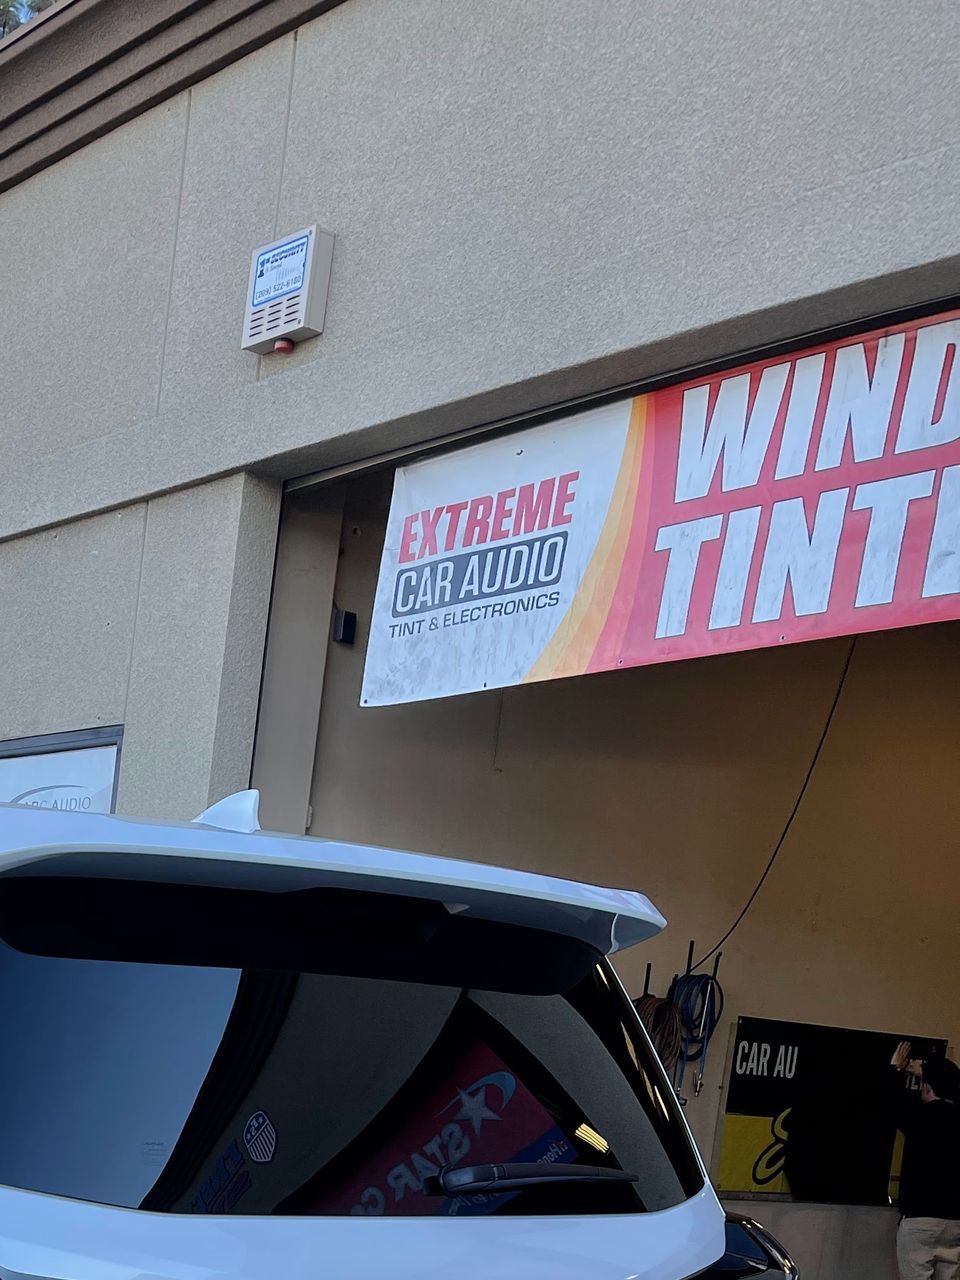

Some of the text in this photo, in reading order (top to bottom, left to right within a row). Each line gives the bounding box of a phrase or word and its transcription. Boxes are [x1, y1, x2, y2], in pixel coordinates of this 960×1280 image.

[398, 471, 580, 564] EXTREME
[395, 536, 565, 613] CAR AUDIO
[389, 591, 560, 638] TINT & ELECTRONICS
[52, 796, 91, 811] AUDIO
[736, 1040, 771, 1076] CAR
